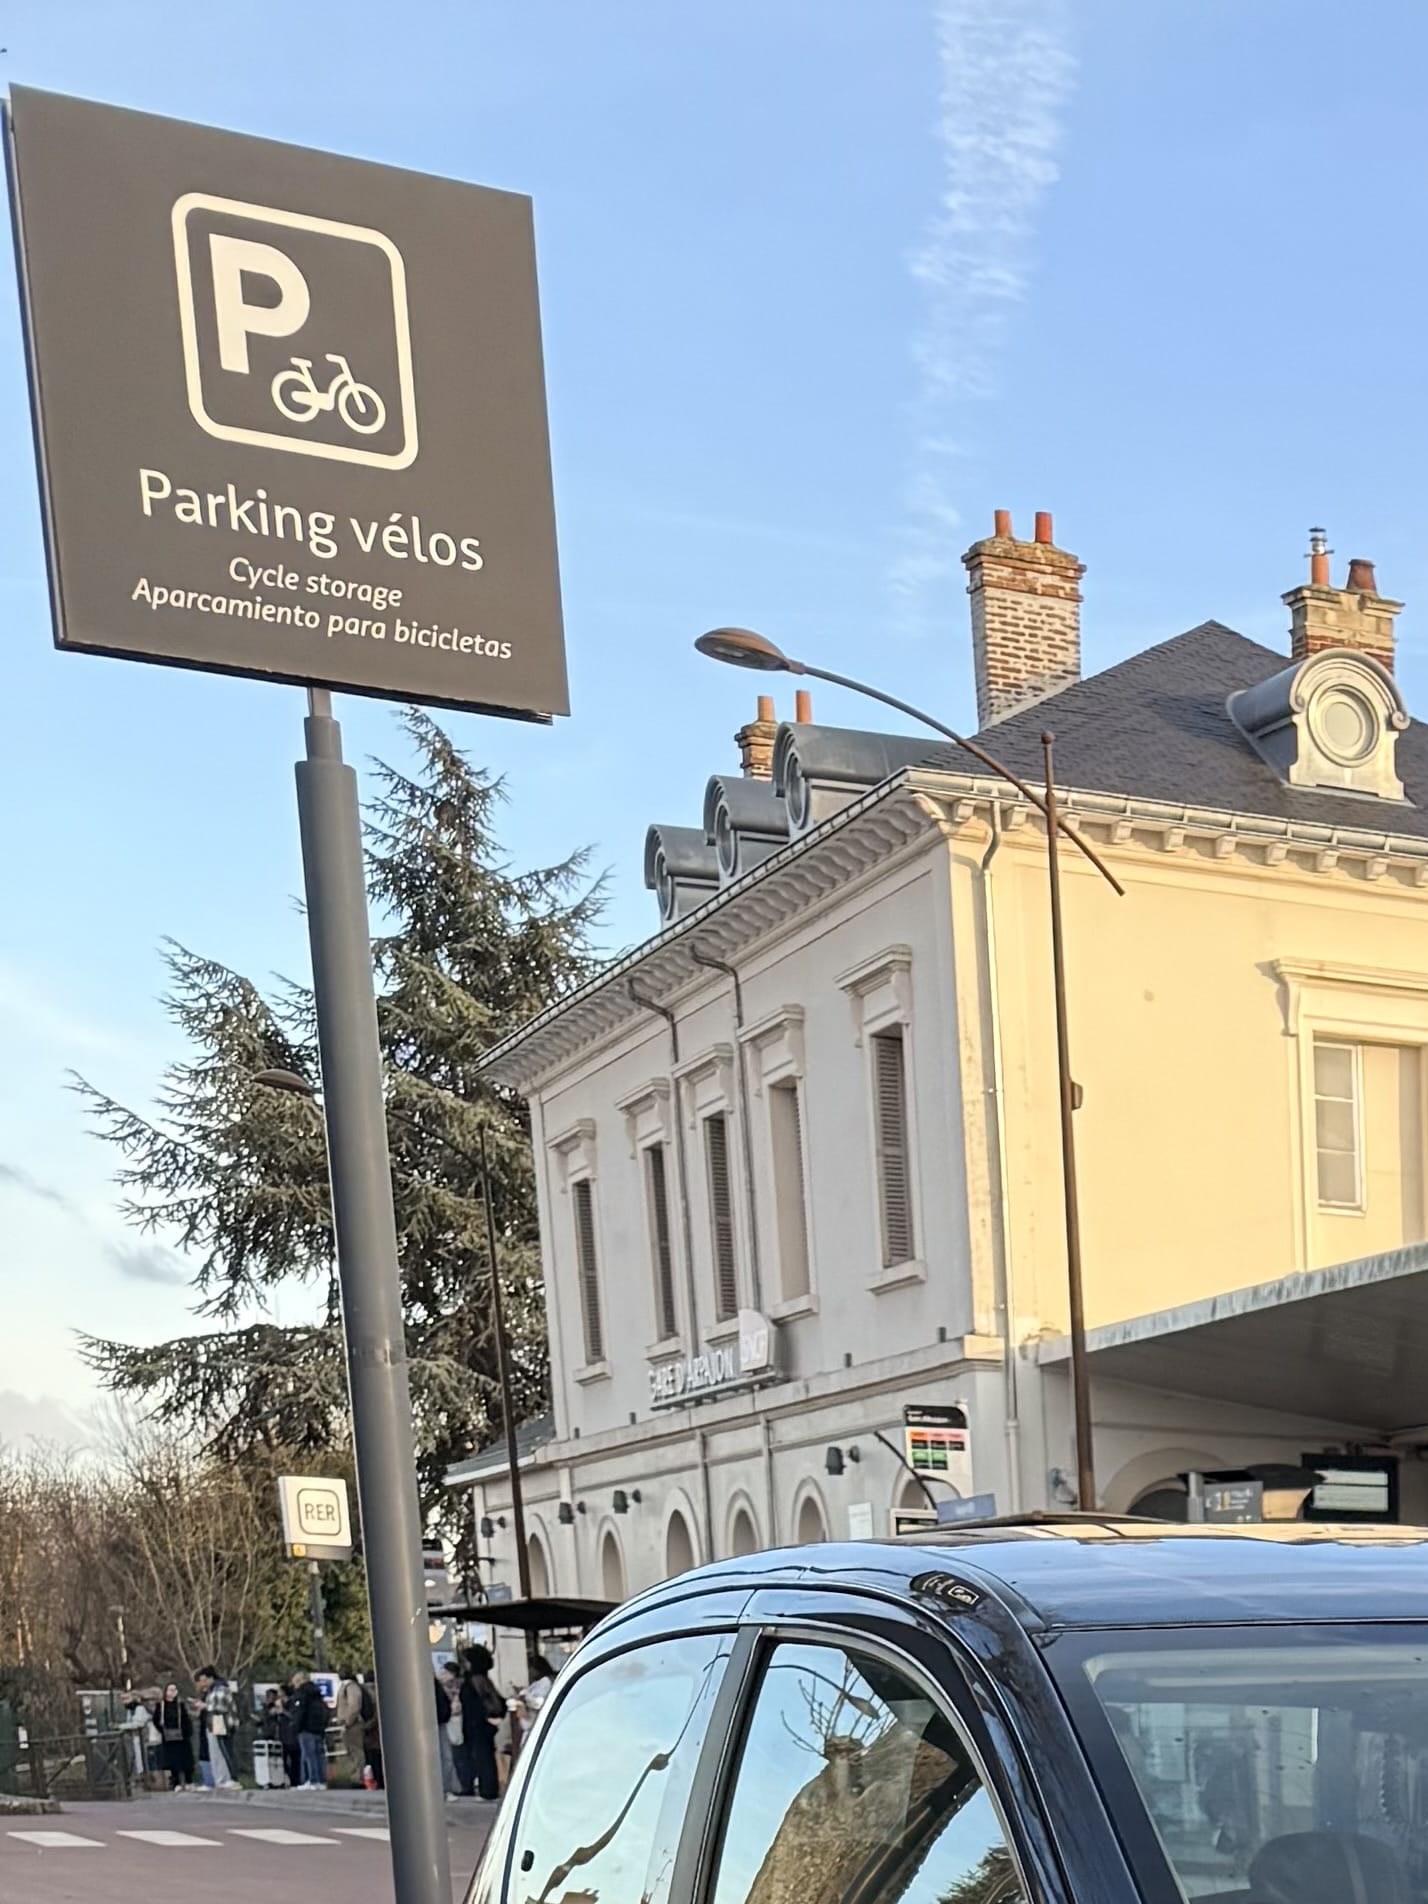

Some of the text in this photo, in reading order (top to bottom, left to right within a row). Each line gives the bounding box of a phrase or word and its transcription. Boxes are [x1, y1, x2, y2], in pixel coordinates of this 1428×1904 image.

[208, 233, 311, 375] P
[138, 468, 485, 572] Parking vélos
[131, 576, 513, 660] Aparcamiento para bicicletas
[228, 555, 404, 608] Cycle storage
[304, 1503, 336, 1521] RER
